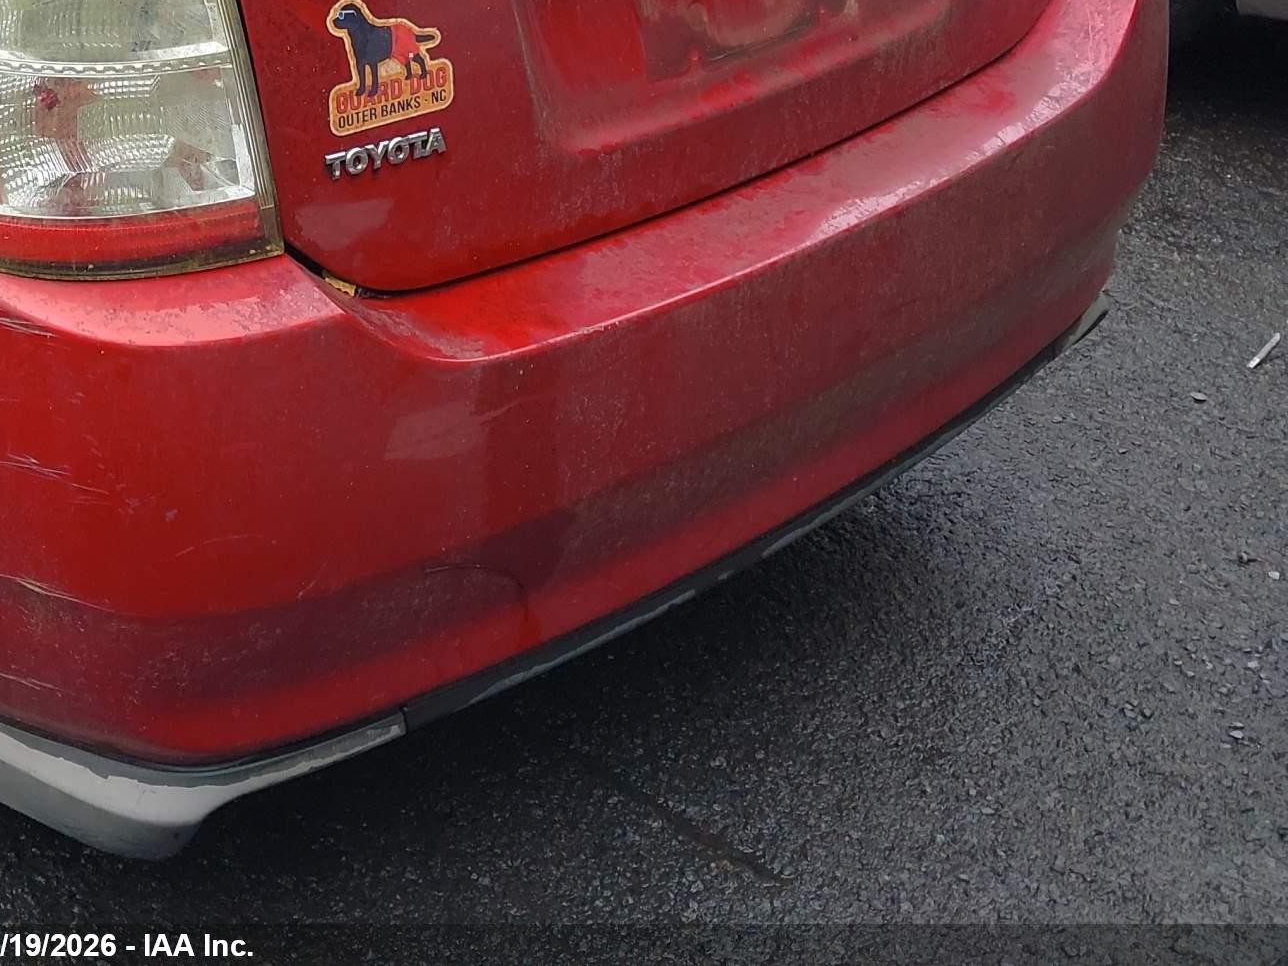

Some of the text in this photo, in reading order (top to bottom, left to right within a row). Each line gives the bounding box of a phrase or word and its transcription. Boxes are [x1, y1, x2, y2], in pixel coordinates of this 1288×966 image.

[409, 66, 447, 95] DOG
[338, 107, 378, 129] OUTER
[380, 95, 422, 118] BANKS
[431, 89, 447, 104] NC
[324, 127, 447, 179] TOYOTA
